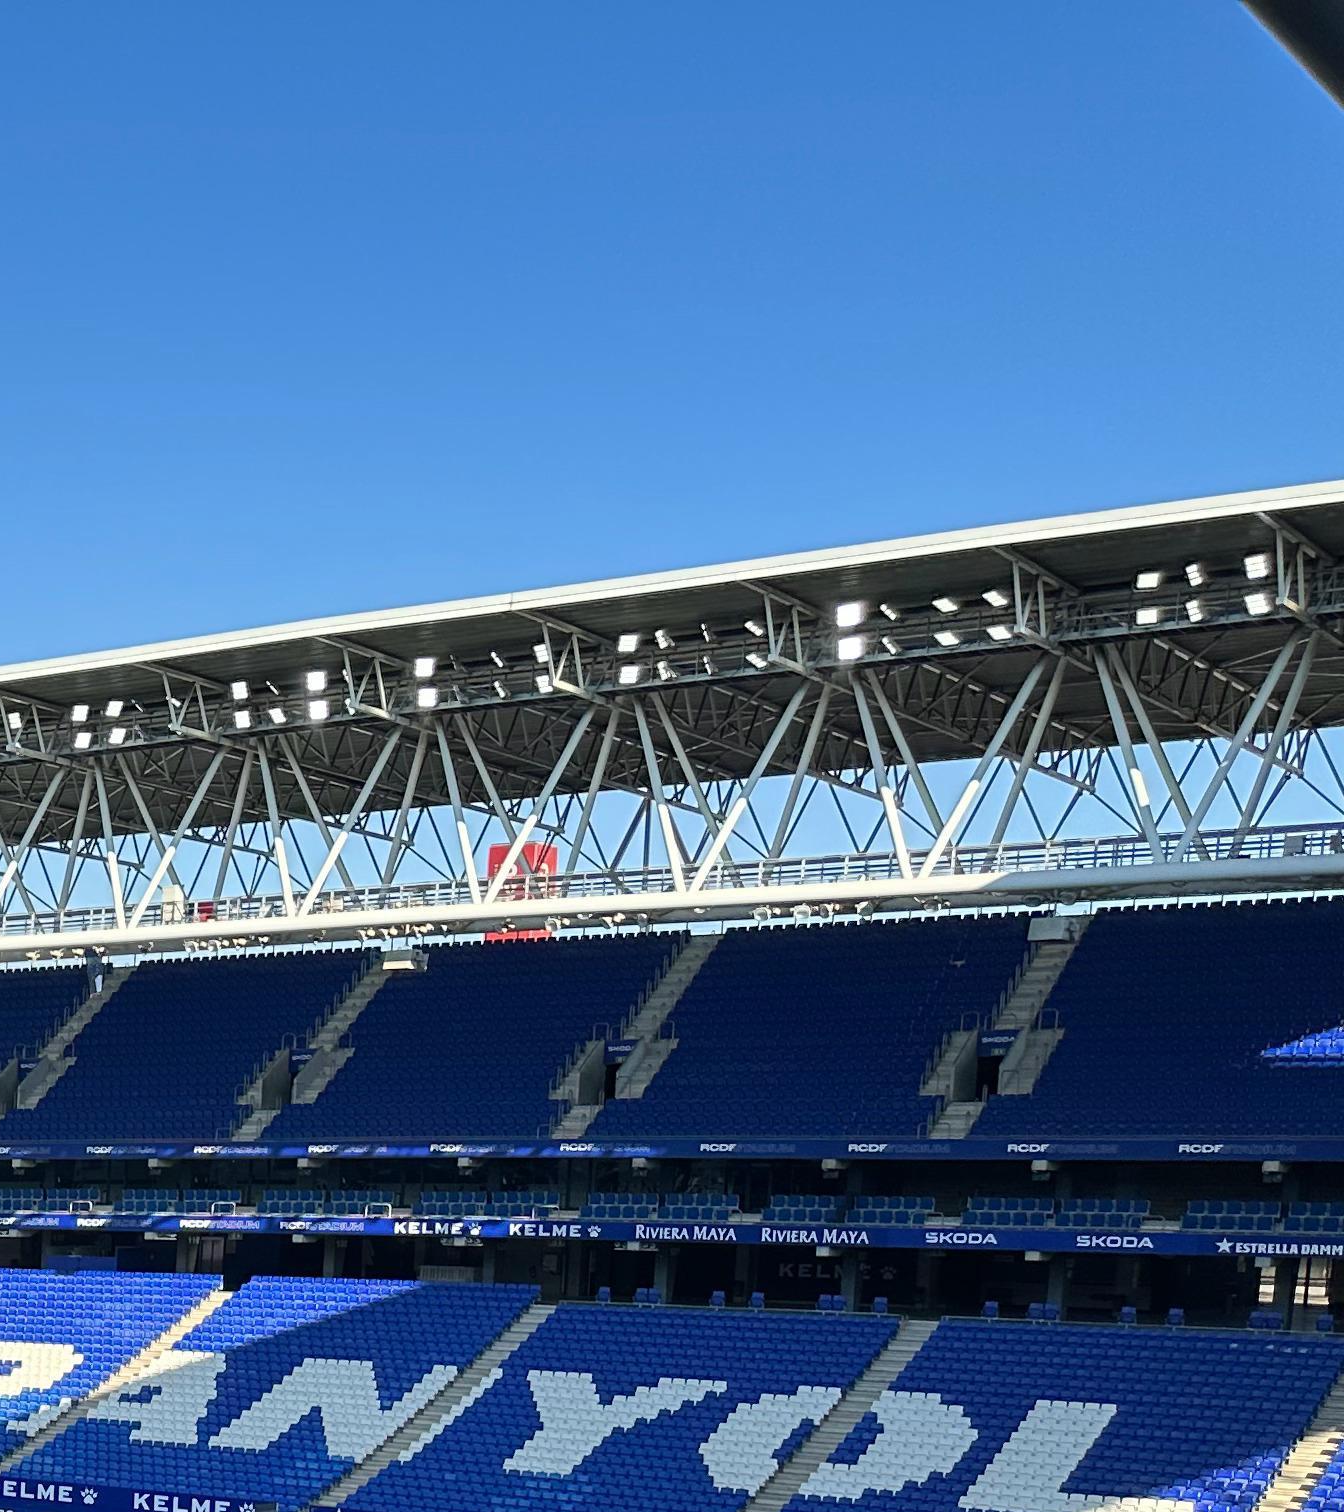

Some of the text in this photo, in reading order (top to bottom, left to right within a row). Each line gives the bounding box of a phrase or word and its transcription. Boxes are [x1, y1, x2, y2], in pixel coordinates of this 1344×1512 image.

[393, 1221, 464, 1235] KELME
[509, 1223, 582, 1238] KELME
[635, 1224, 737, 1242] RIVIERA MAYA
[761, 1227, 869, 1245] RIVIERA MAYA
[1235, 1242, 1344, 1257] ESTRELLA DAMM
